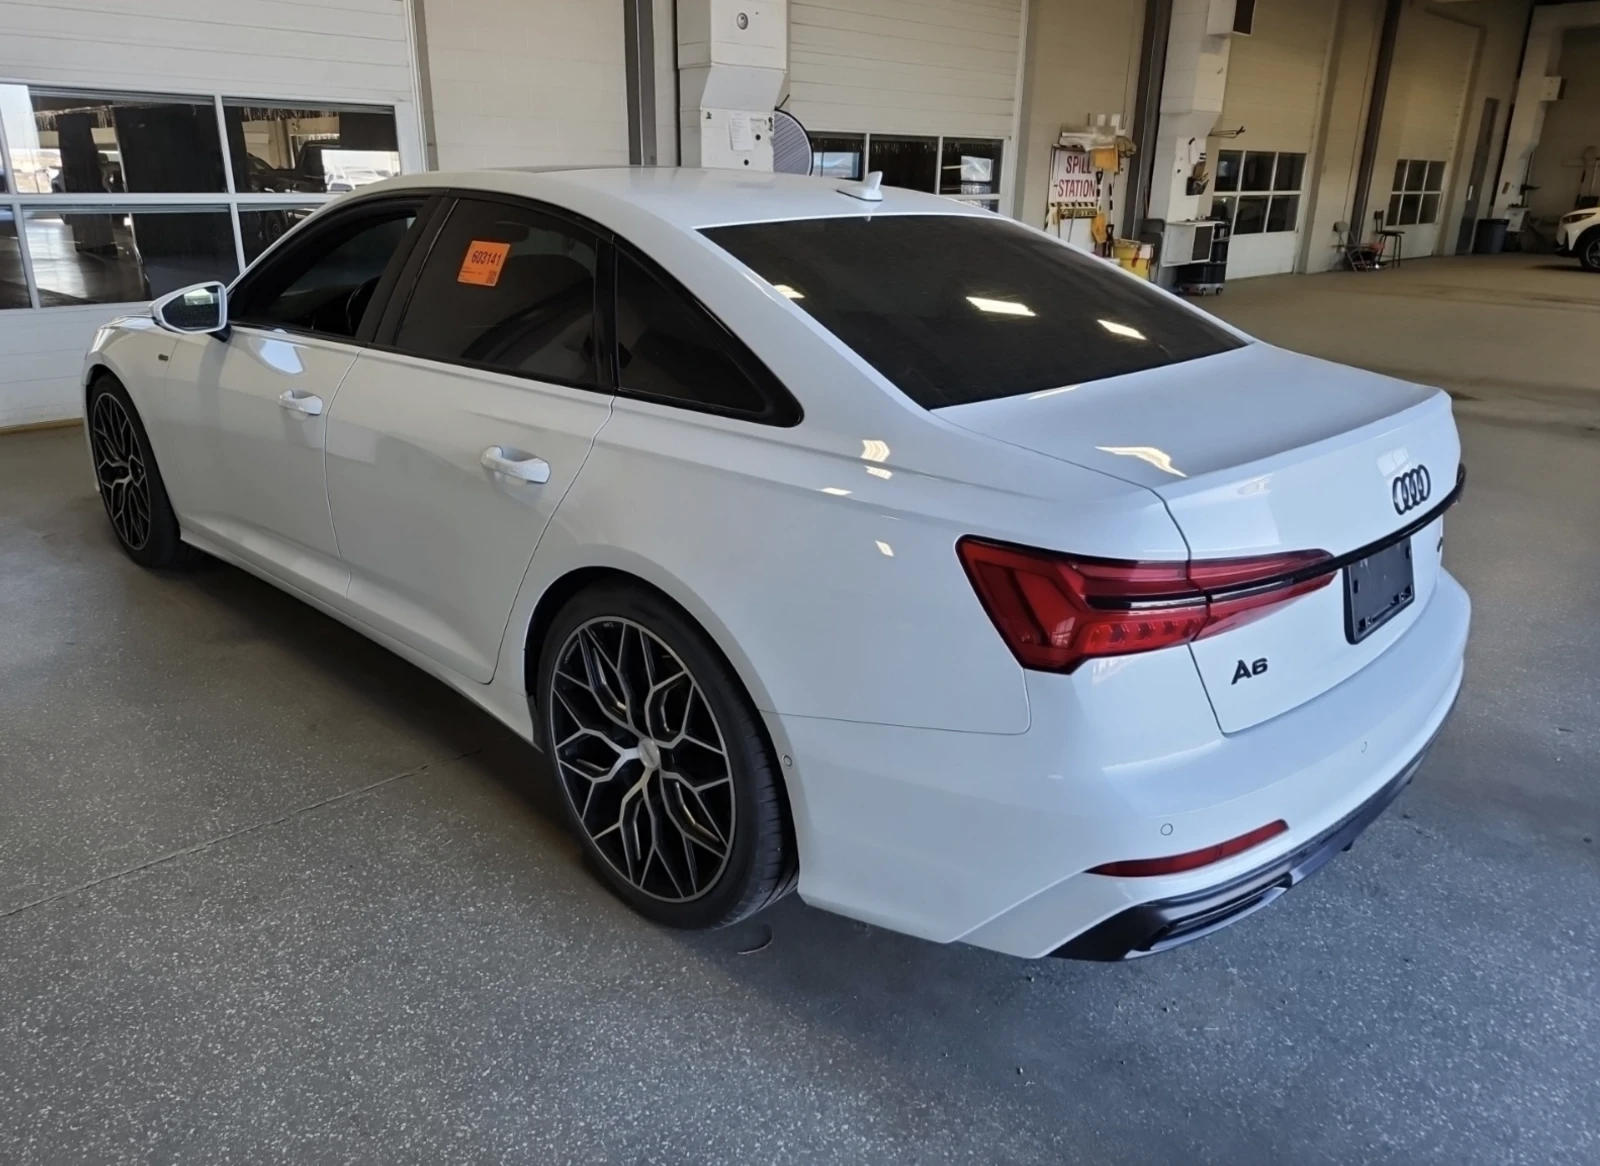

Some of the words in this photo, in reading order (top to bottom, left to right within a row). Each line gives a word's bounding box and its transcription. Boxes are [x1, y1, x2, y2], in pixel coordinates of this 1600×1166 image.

[1066, 155, 1092, 174] SPILL
[1058, 179, 1096, 197] STATION
[471, 250, 503, 266] 603141
[1231, 657, 1269, 685] A6
